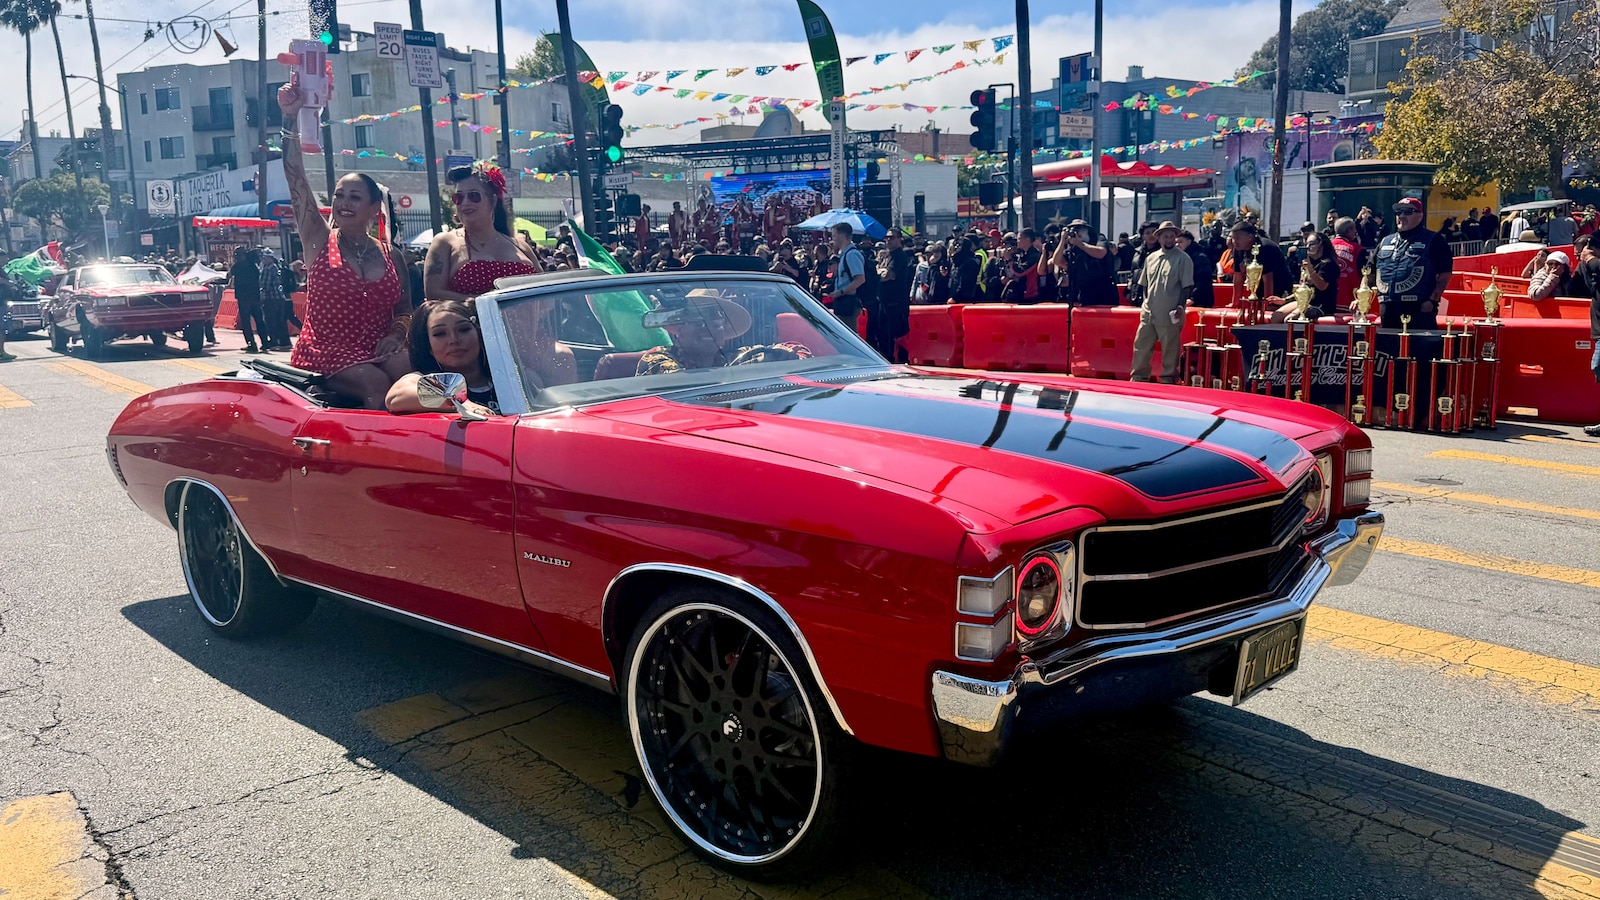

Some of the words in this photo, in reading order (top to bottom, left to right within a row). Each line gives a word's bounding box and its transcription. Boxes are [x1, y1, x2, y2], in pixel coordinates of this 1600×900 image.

[376, 26, 400, 34] SPEED
[380, 33, 398, 41] LIMIT
[379, 41, 400, 56] 20
[834, 162, 840, 170] St
[188, 170, 225, 196] TAQUERIA
[608, 176, 628, 184] Mission
[189, 196, 203, 213] LOS
[207, 190, 231, 210] ALTOS
[523, 551, 571, 567] MALIBU
[1241, 658, 1257, 693] 71
[1264, 634, 1298, 678] VLLE
